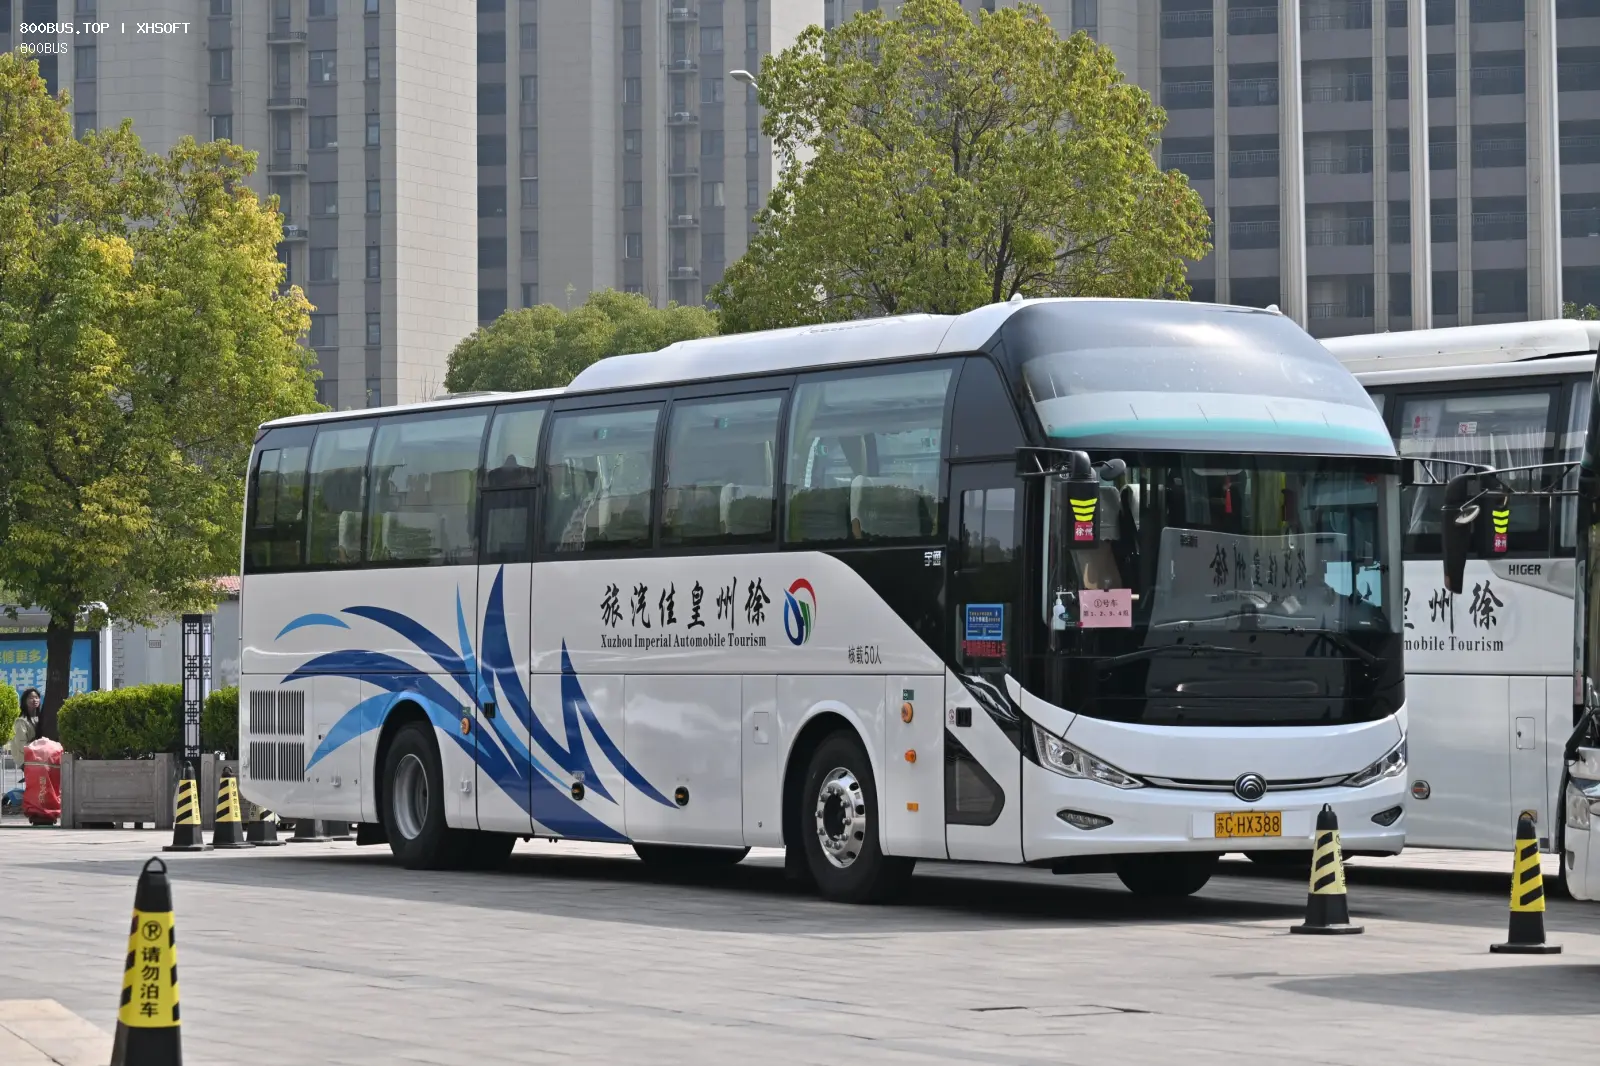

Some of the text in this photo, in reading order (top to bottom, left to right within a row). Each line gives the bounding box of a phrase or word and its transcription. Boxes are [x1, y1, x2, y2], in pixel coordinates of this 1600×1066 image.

[1508, 564, 1541, 576] HIGER
[601, 632, 767, 650] Xuzhou Imperial Automobile Tourism
[1448, 635, 1504, 651] Tourism
[140, 946, 161, 1018] 请勿泊车
